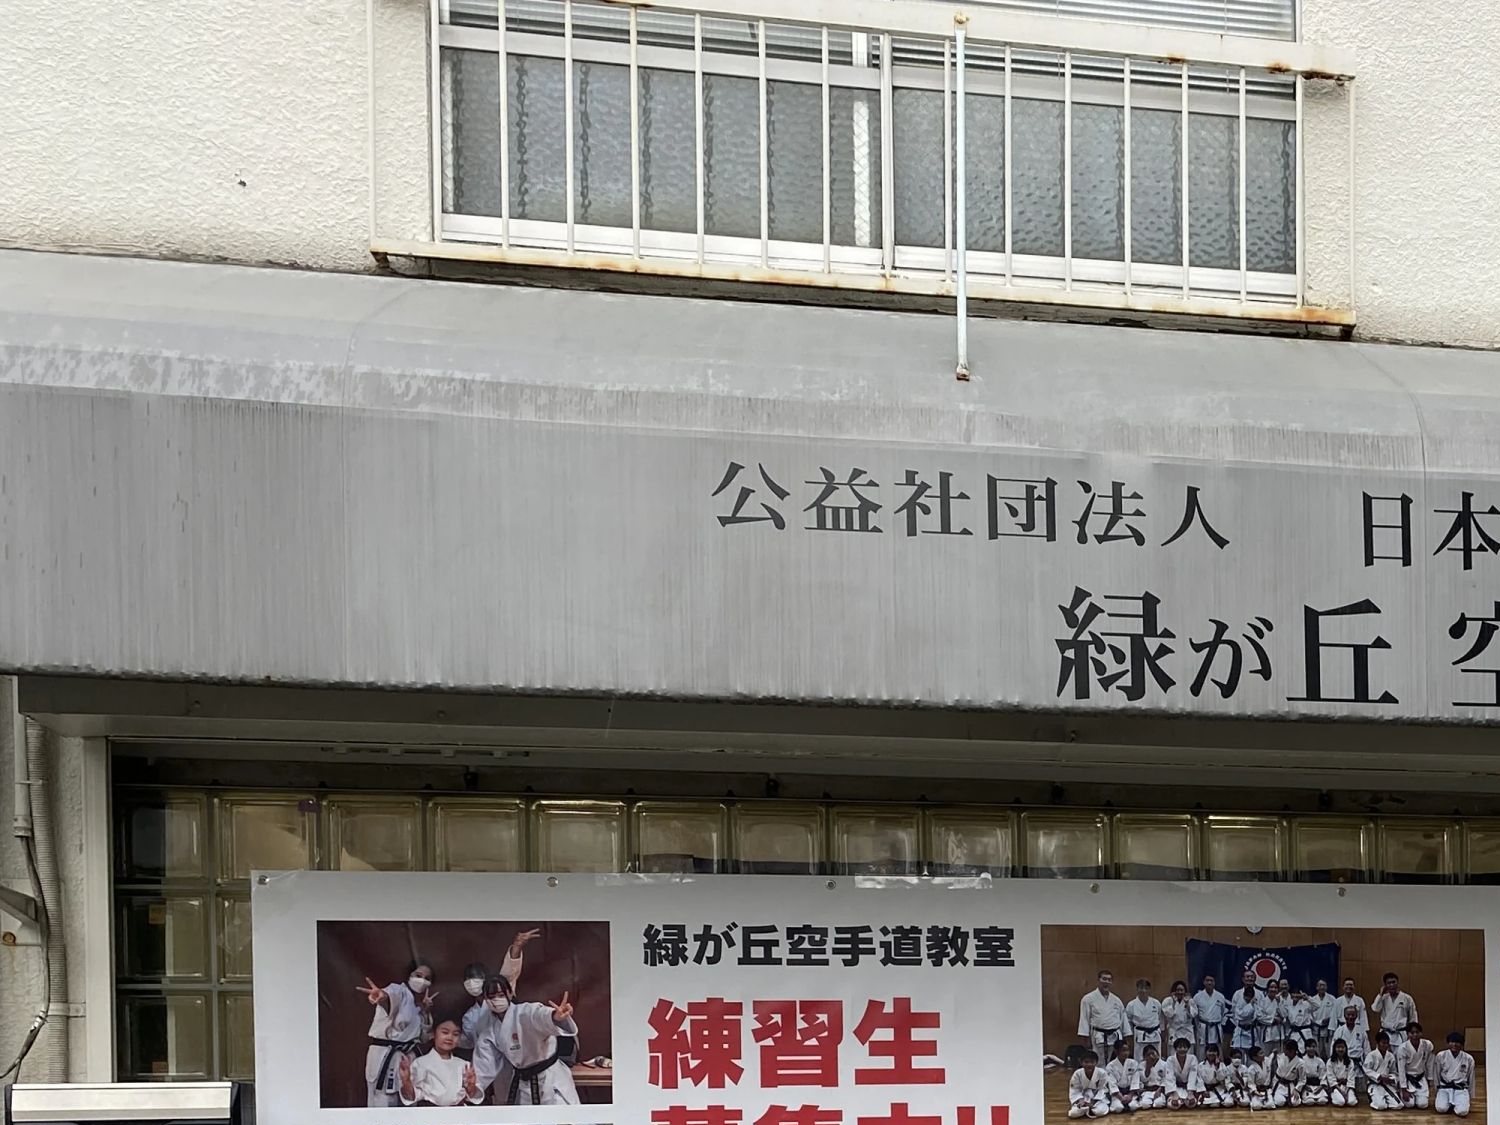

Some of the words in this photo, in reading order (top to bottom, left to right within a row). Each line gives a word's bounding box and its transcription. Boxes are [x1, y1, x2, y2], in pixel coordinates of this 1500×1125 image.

[711, 461, 1231, 550] 公益社団法人
[643, 923, 1015, 967] 緑が丘空手道教室
[647, 996, 946, 1089] 練習生
